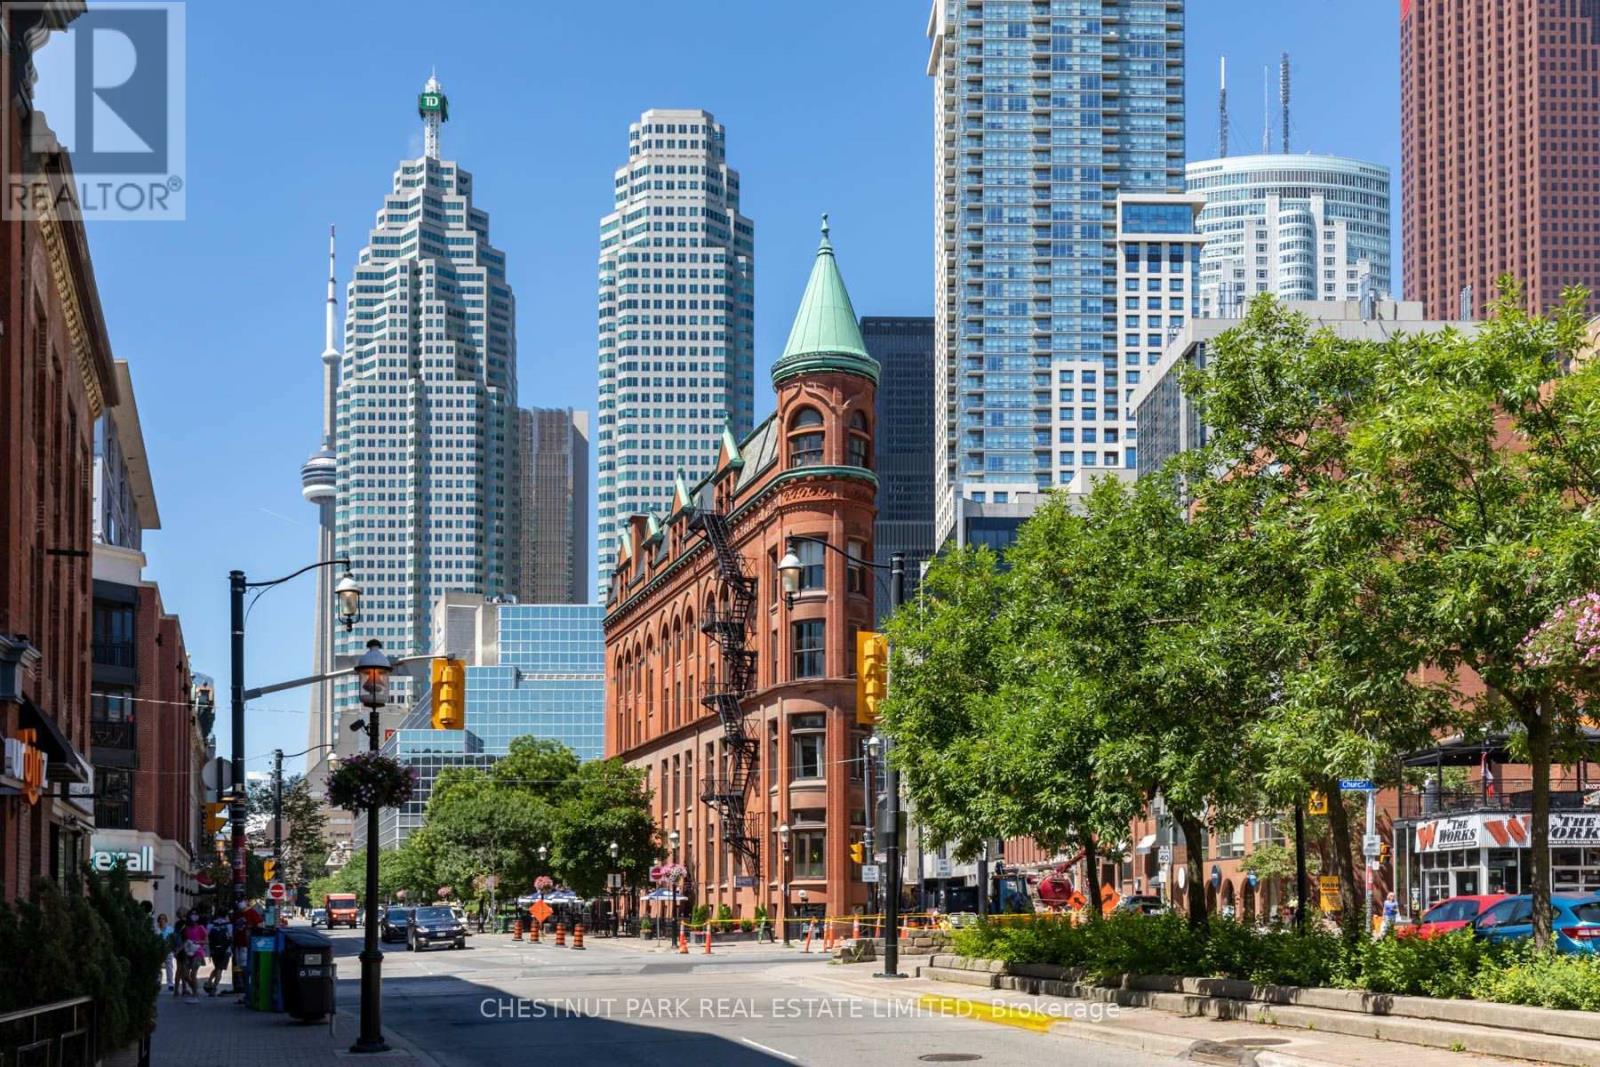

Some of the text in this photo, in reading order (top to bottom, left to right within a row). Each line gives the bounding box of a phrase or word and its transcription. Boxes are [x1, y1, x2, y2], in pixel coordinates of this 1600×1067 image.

[424, 96, 438, 107] TD
[1450, 819, 1469, 830] THE
[1559, 816, 1597, 827] THE
[1417, 821, 1439, 850] W
[1439, 828, 1477, 843] WORKS
[1160, 854, 1169, 862] 40
